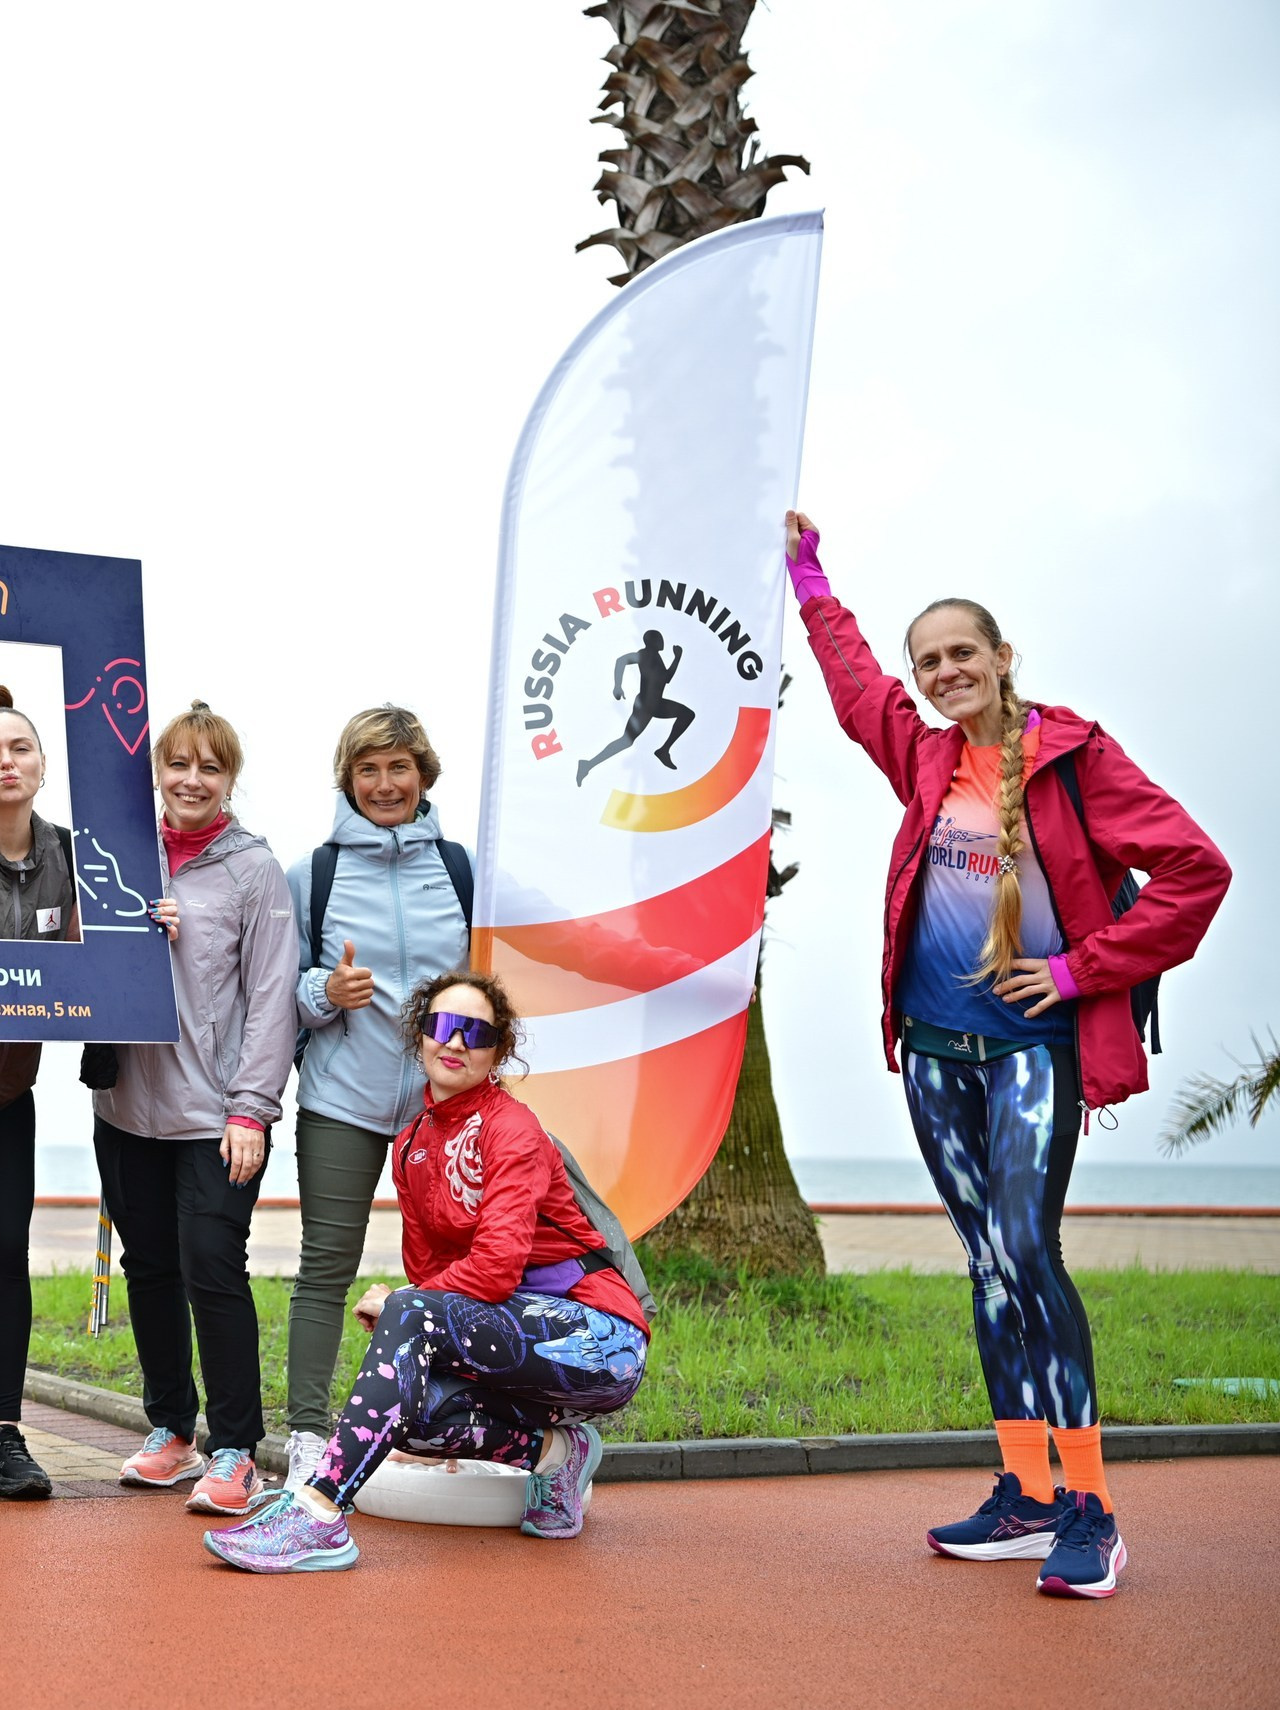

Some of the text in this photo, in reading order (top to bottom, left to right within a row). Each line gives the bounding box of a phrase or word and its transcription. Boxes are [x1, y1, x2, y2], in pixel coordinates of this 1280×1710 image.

[523, 579, 763, 760] RUSSIA RUNNING
[54, 1002, 65, 1017] 5
[68, 1006, 91, 1017] км
